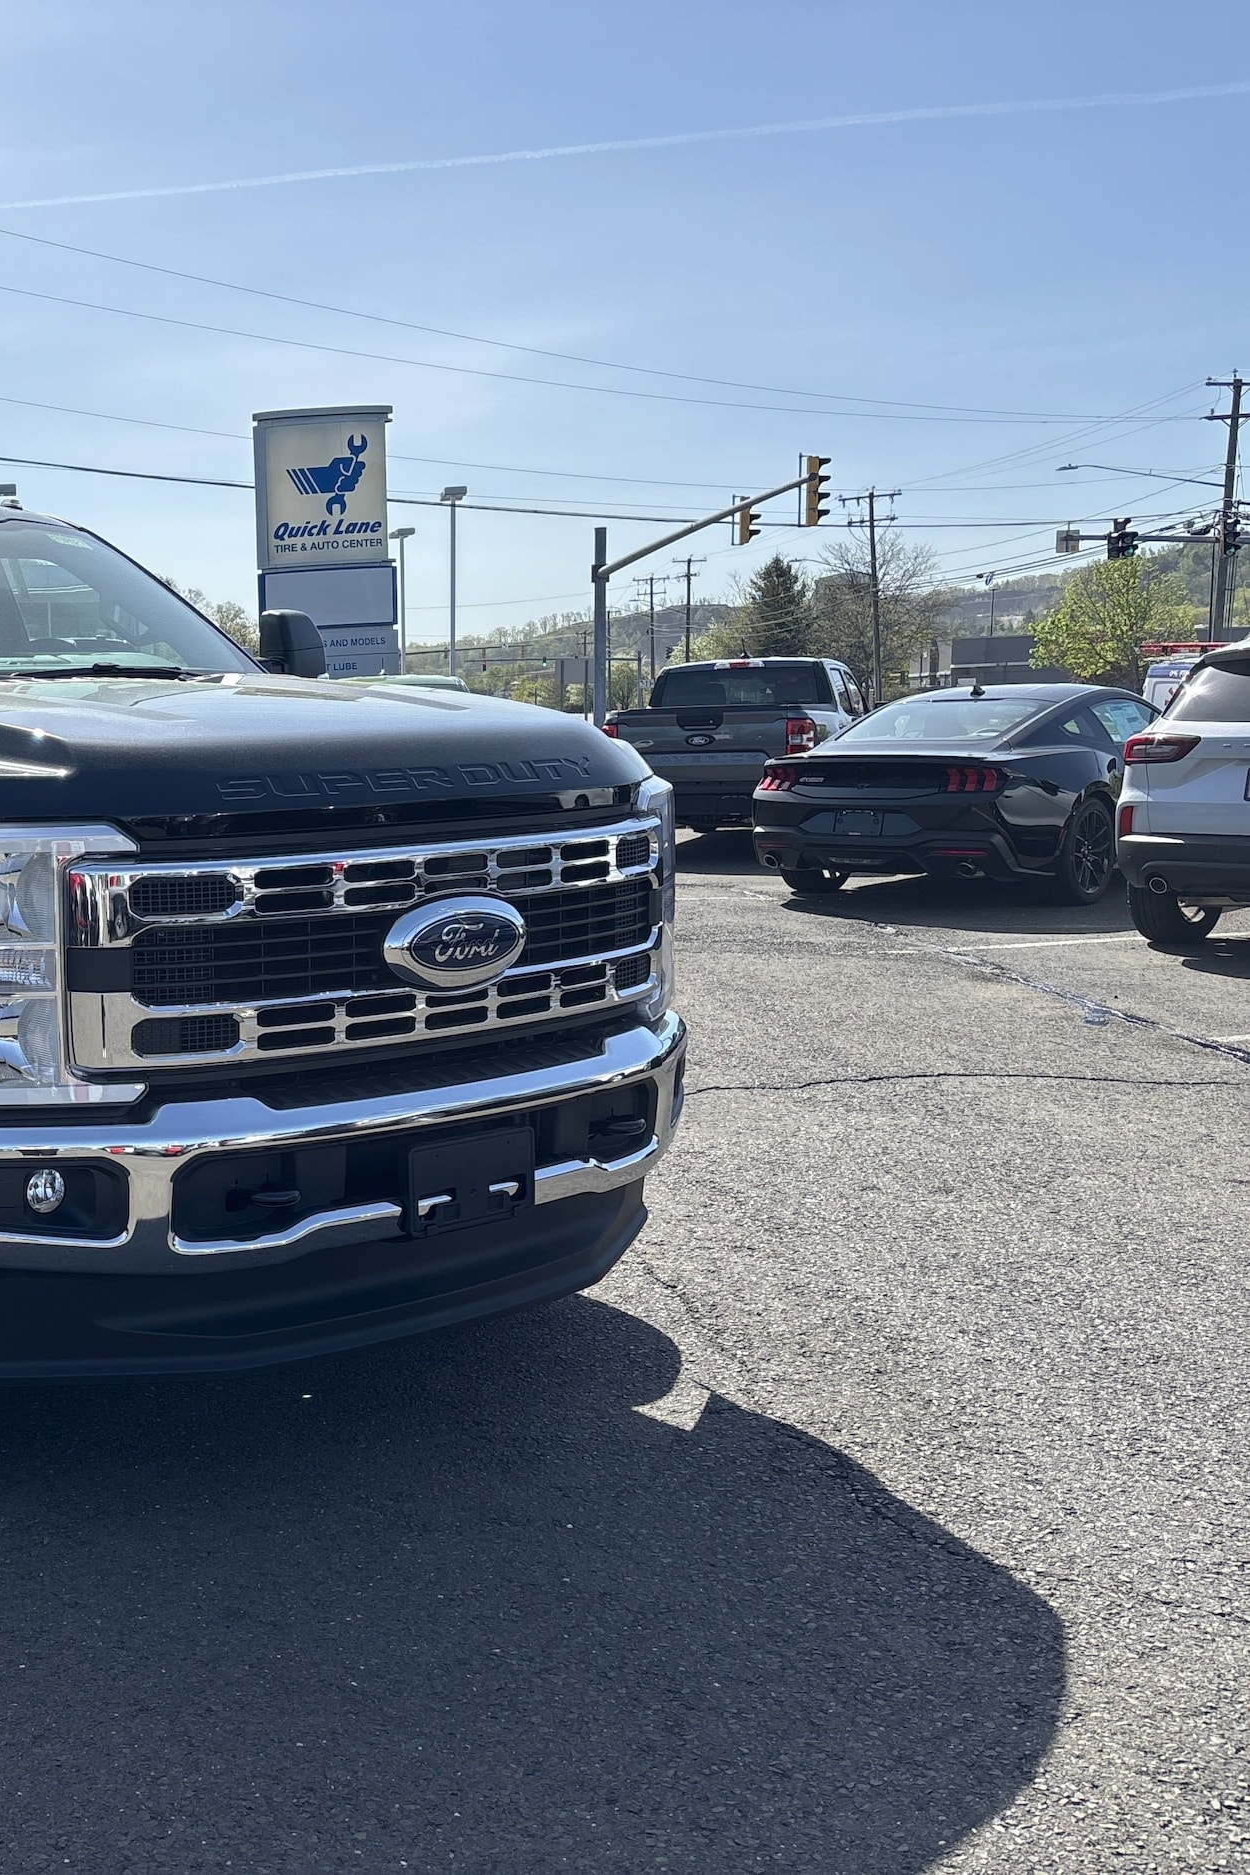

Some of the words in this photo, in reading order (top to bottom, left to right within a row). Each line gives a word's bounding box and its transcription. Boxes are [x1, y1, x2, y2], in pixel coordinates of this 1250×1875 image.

[273, 520, 332, 541] Quick
[333, 519, 382, 535] Lane
[274, 543, 298, 554] TIRE
[300, 543, 308, 552] &
[310, 540, 339, 551] AUTO
[342, 538, 383, 549] CENTER
[330, 639, 349, 648] AND
[350, 636, 386, 647] MODELS
[333, 662, 358, 671] LUBE
[216, 768, 454, 801] SUPER
[457, 757, 592, 787] DUTY
[434, 922, 500, 963] Ford
